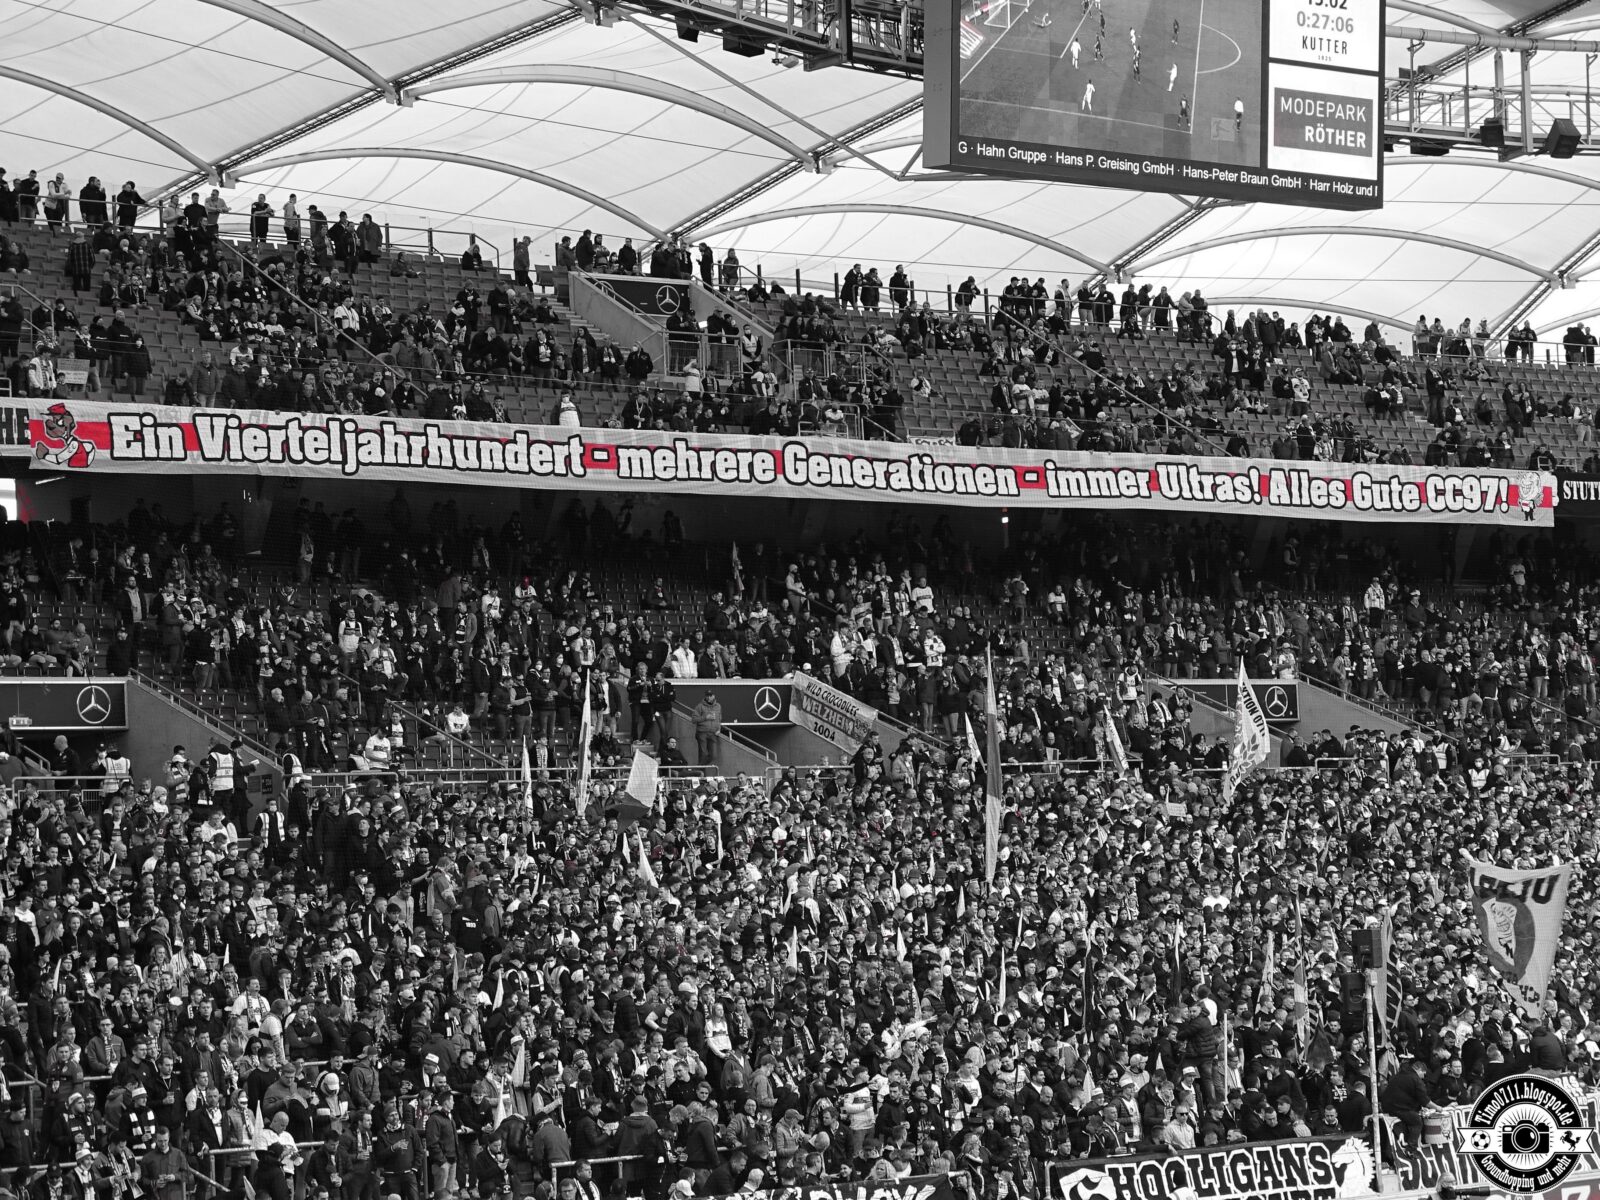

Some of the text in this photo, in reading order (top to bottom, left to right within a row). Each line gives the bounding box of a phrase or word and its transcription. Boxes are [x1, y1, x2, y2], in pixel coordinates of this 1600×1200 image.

[1296, 10, 1354, 34] 0:27:06
[1302, 35, 1348, 55] KUTTER
[1280, 96, 1367, 122] MODEPARK
[1304, 123, 1366, 148] RÖTHER
[977, 143, 1005, 158] Hahn
[1008, 146, 1047, 164] Gruppe
[1056, 151, 1083, 166] Hans
[1086, 154, 1095, 168] P.
[1098, 156, 1140, 175] Greising
[1142, 161, 1174, 176] GmbH
[1183, 165, 1238, 183] Hans-Peter
[1240, 172, 1269, 186] Braun
[1271, 174, 1301, 189] GmbH
[1310, 179, 1330, 192] Harr
[1333, 181, 1354, 195] Holz
[1355, 184, 1373, 197] und
[107, 411, 188, 462] Ein
[191, 412, 587, 478] Vierteljahrhundert
[616, 437, 777, 485] mehrere
[781, 440, 1020, 498] Generationen
[1043, 458, 1153, 499] immer
[1154, 461, 1262, 505] Ultras!
[1267, 467, 1347, 509] Alles
[1350, 470, 1424, 513] Gute
[1424, 473, 1510, 514] CC97!
[806, 681, 822, 697] WILD
[802, 694, 854, 736] WELZHEIM
